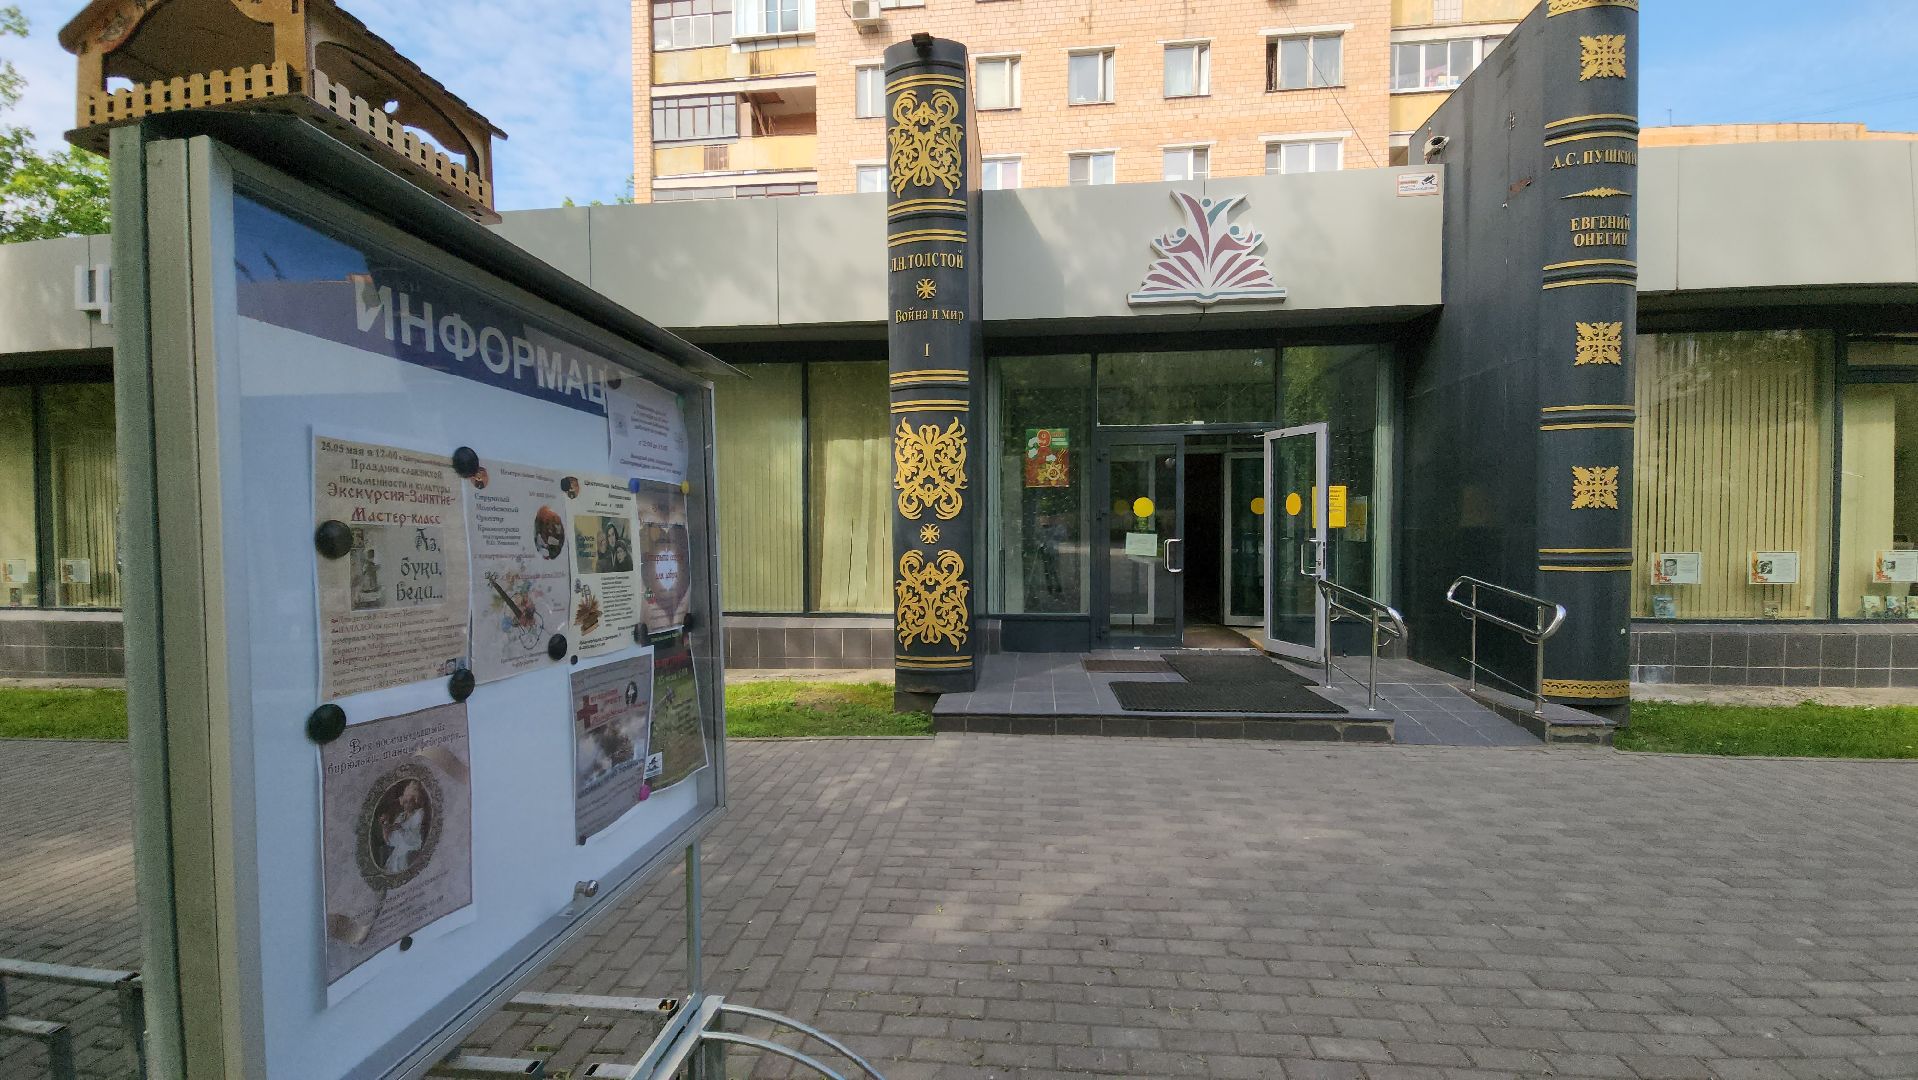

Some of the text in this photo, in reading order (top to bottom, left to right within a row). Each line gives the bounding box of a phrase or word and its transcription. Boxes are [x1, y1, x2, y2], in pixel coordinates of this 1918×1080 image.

[1551, 152, 1580, 169] А.С.
[1570, 213, 1631, 231] ЕВГЕНИЙ
[1573, 232, 1629, 247] ОНЕГИН
[908, 250, 964, 269] ТОЛСТОЙ
[895, 307, 964, 325] Война и мир
